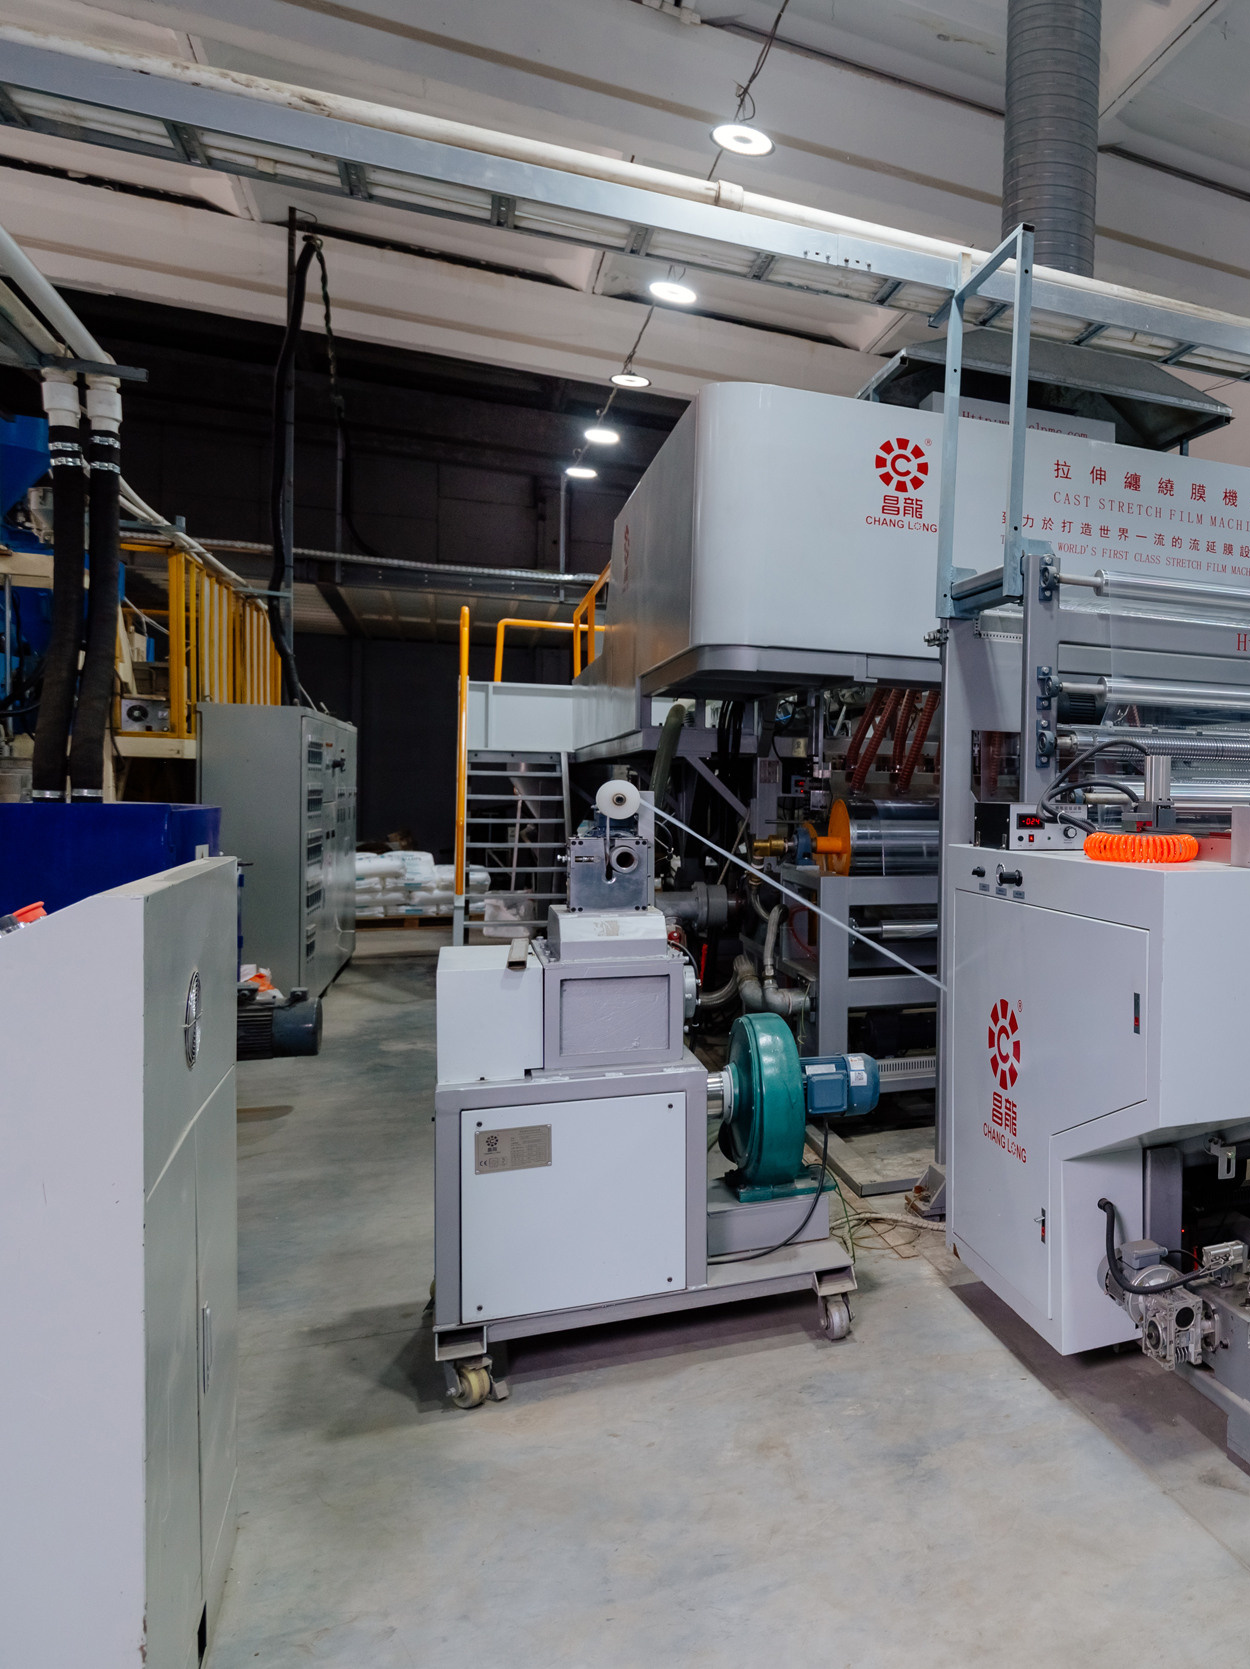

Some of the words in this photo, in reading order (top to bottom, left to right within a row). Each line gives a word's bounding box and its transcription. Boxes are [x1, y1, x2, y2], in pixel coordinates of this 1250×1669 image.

[881, 495, 923, 519] 昌龍
[1054, 491, 1090, 507] CAST
[1099, 498, 1162, 518] STRETCH
[1169, 509, 1203, 525] FILM
[865, 515, 905, 529] CHANG
[908, 521, 938, 533] LONG
[1057, 542, 1097, 556] WORLD'S
[1102, 548, 1129, 560] FIRST
[1134, 552, 1161, 565] CLASS
[1166, 556, 1202, 570] STRETCH
[1206, 562, 1227, 573] FILM
[991, 1091, 1017, 1137] 昌龍
[982, 1122, 1006, 1149] CHANG
[1007, 1140, 1027, 1164] LONG
